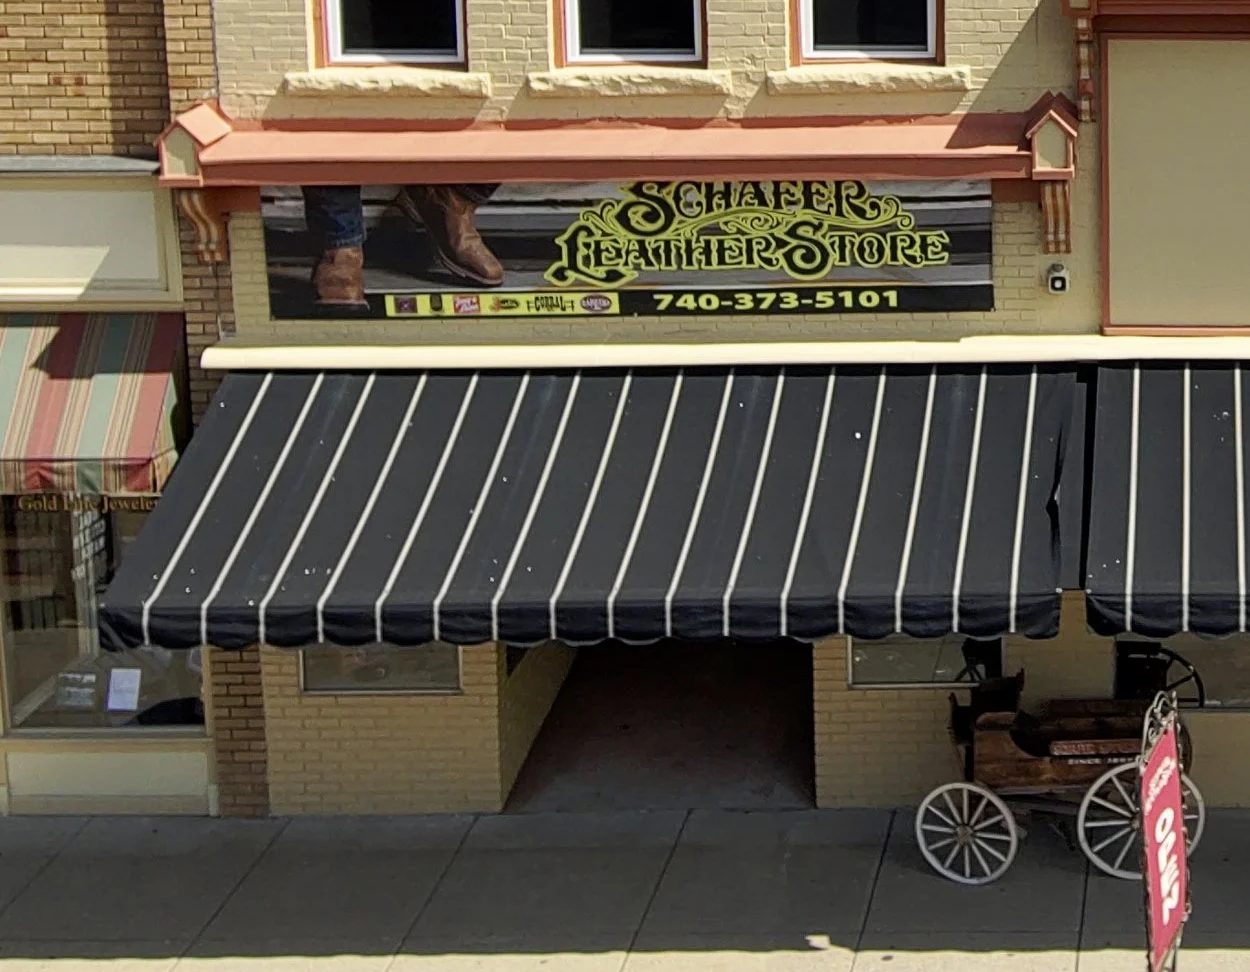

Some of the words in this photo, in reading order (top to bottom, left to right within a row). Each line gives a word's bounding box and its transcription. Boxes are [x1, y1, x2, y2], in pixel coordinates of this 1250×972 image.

[612, 180, 882, 238] SCHAFER
[543, 221, 780, 289] LEATHER
[774, 218, 952, 280] STORE
[652, 290, 898, 311] 740-373-5101
[18, 495, 58, 512] Gold
